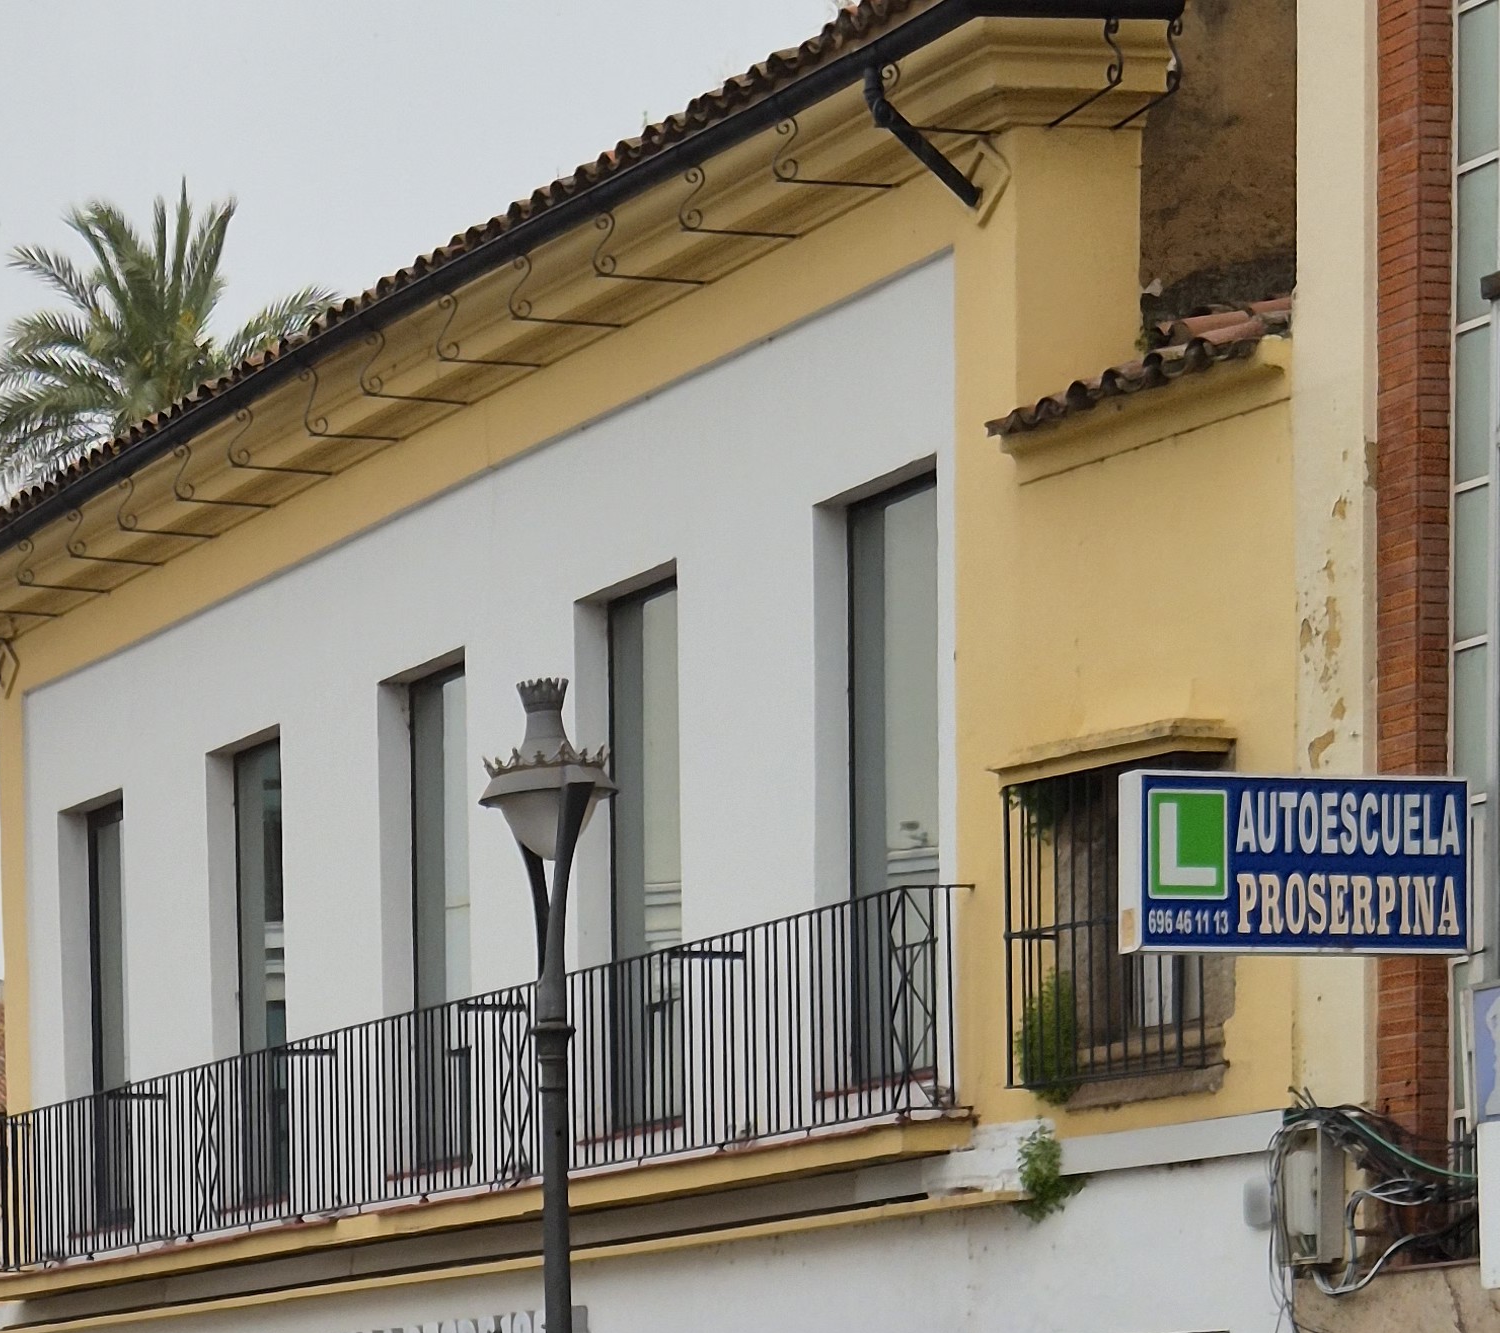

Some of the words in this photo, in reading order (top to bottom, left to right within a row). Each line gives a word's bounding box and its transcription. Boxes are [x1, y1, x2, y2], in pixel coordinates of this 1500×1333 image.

[1235, 790, 1461, 856] AUTOESCUELA
[1148, 908, 1173, 935] 696
[1175, 908, 1192, 935] 46
[1195, 908, 1209, 935] 11
[1213, 908, 1229, 935] 13
[1236, 872, 1461, 936] PROSERPINA
